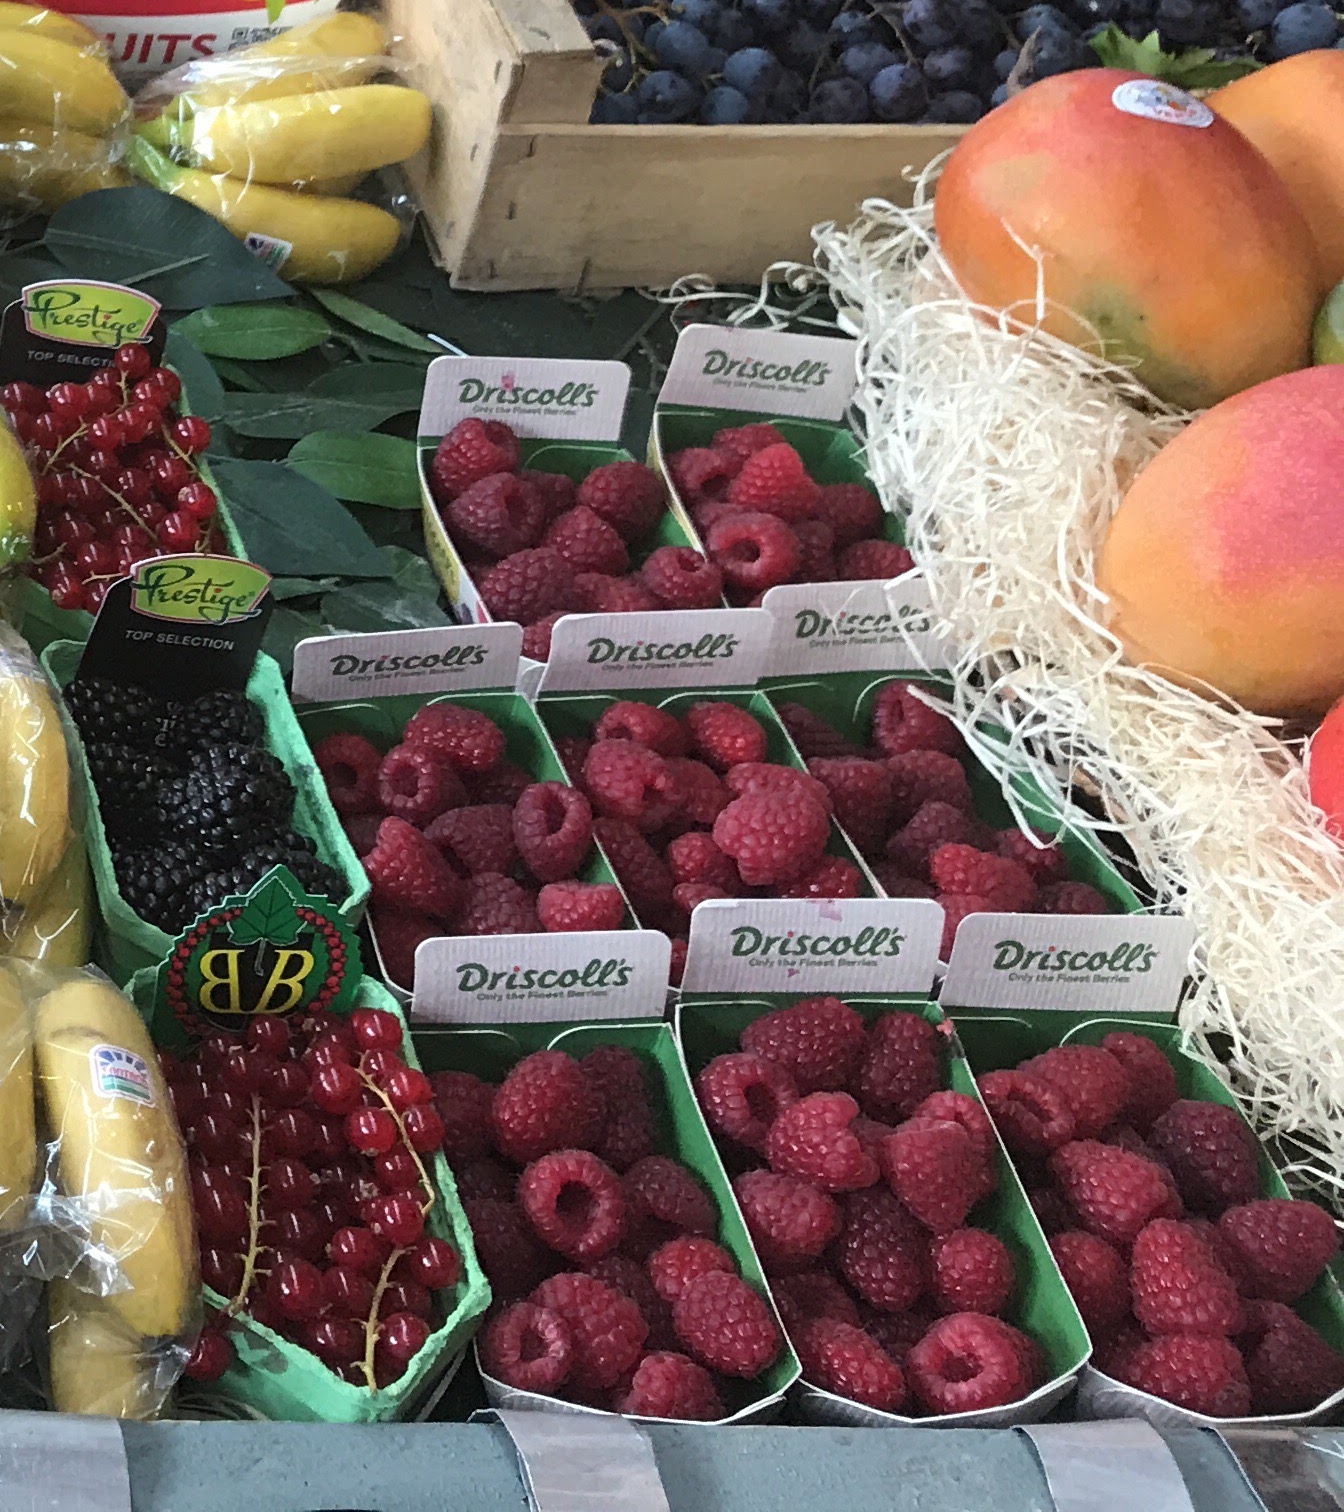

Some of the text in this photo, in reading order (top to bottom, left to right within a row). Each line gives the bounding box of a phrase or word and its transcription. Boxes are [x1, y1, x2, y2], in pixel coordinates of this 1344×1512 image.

[22, 289, 154, 346] Prestige
[27, 350, 116, 369] TOP SELECTI
[702, 349, 834, 386] Driscoll's
[458, 377, 599, 408] Driscoll's
[132, 564, 263, 626] Prestige
[125, 629, 236, 652] TOP SELECTION
[586, 633, 740, 665] Driscoll's
[332, 644, 490, 676] Driscoll's
[731, 926, 905, 958] Driscoll's
[991, 939, 1160, 973] Driscoll's
[457, 958, 634, 992] Driscoll's
